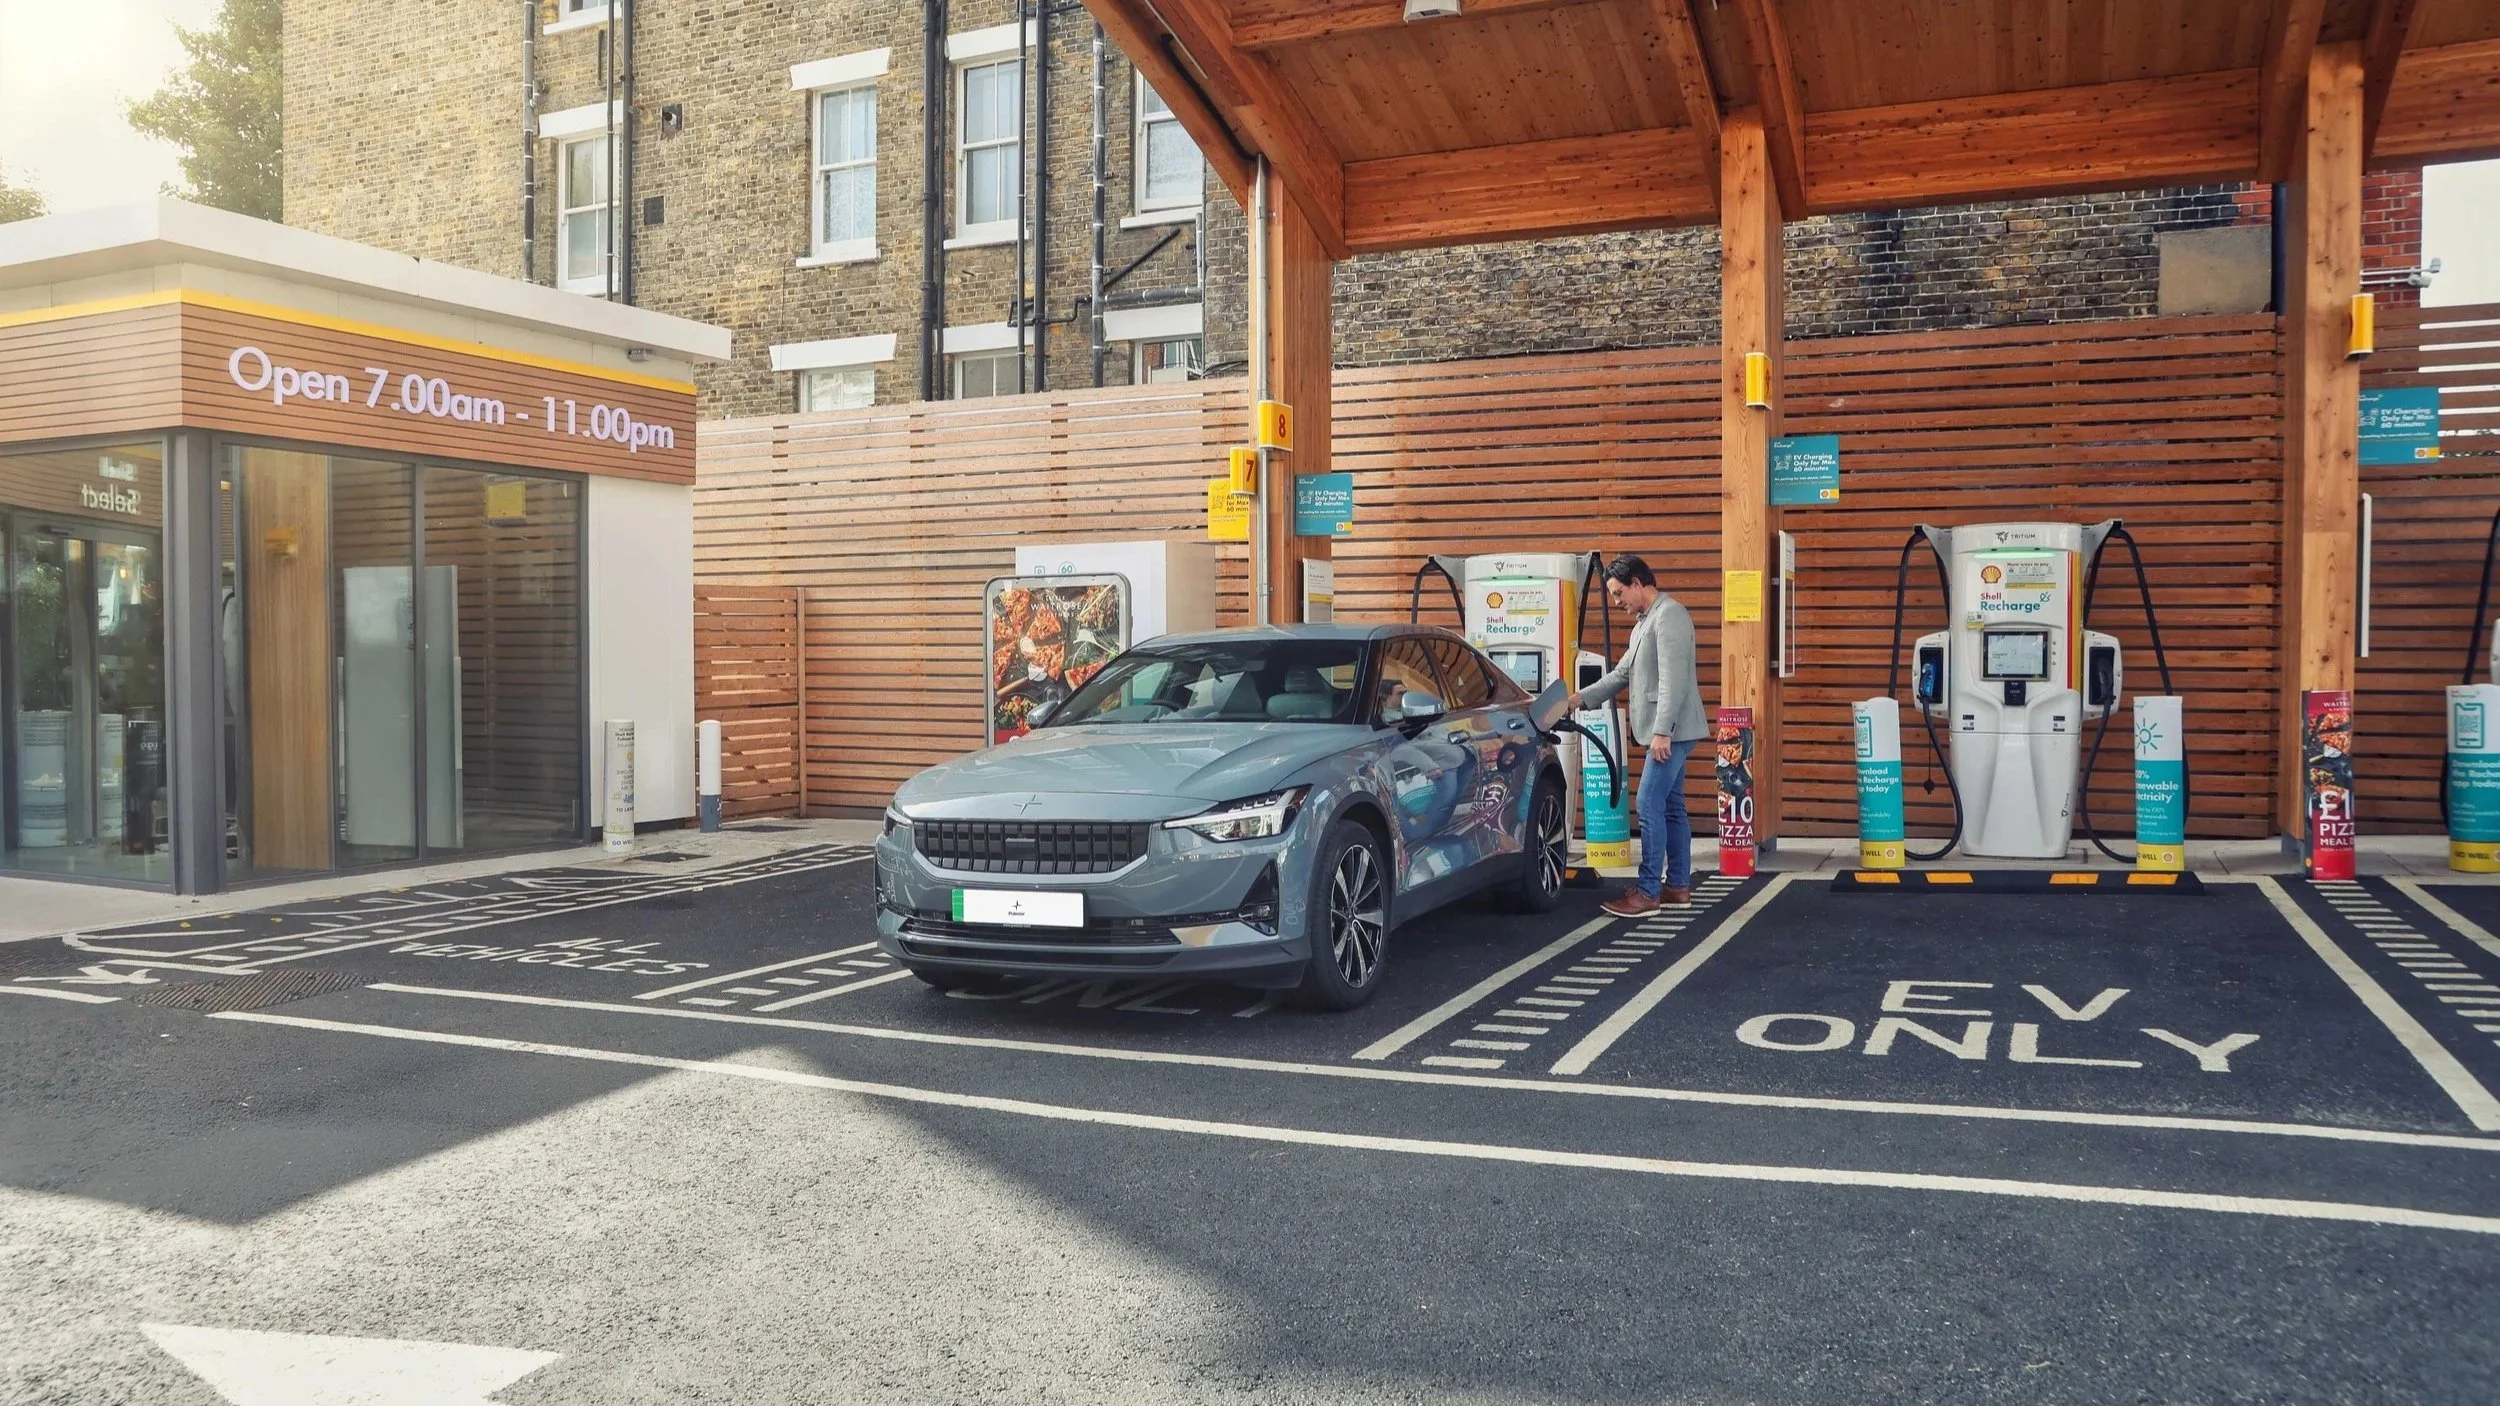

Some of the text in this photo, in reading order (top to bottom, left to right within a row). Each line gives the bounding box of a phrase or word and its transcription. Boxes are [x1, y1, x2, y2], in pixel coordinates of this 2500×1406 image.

[228, 346, 350, 405] Open
[364, 366, 505, 425] 7.00am
[542, 396, 675, 453] 11.00pm
[1278, 414, 1286, 438] 8
[1804, 454, 1832, 462] Charging
[1246, 460, 1254, 482] 7
[1061, 565, 1073, 574] 60
[1980, 592, 2002, 600] Shell
[1980, 600, 2040, 613] Recharge
[1486, 624, 1536, 636] Recharge
[1864, 776, 1900, 784] Recharge
[1866, 786, 1889, 794] today
[1718, 796, 1753, 824] £10
[2319, 790, 2354, 820] £1
[2320, 822, 2354, 836] PIZZ
[534, 938, 661, 954] ALL
[389, 941, 709, 974] VEHICLES
[1880, 980, 2130, 1022] EV
[1735, 1013, 2260, 1073] ONLY
